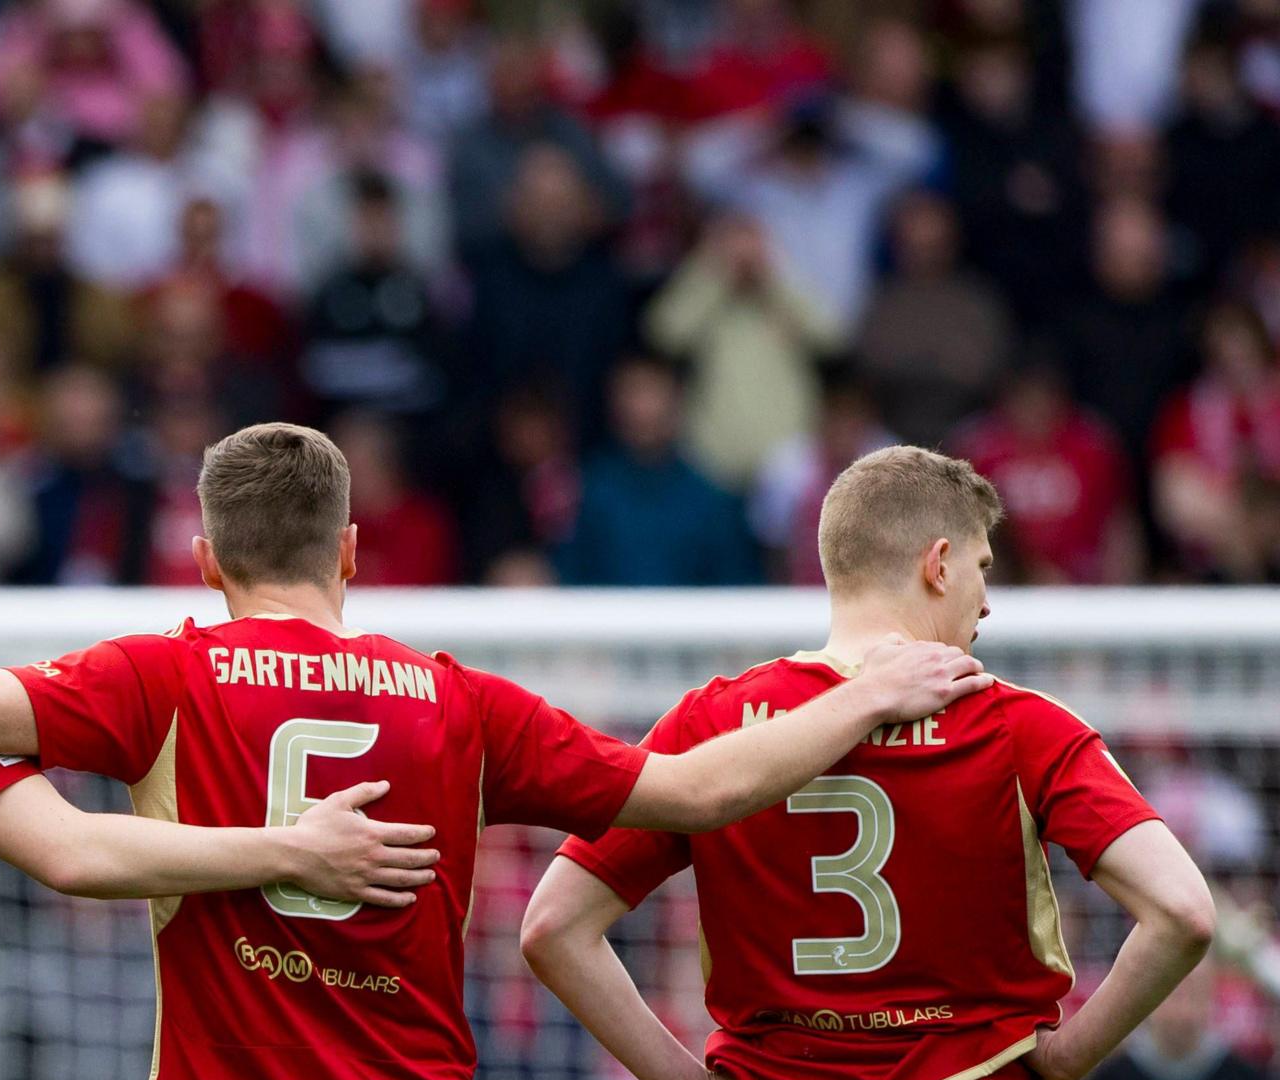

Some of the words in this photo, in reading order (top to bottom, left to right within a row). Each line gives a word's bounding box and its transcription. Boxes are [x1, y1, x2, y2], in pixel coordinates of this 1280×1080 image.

[207, 646, 437, 704] GARTENMANN
[786, 775, 902, 976] 3
[235, 936, 312, 983] RAM
[844, 1005, 954, 1031] TUBULARS
